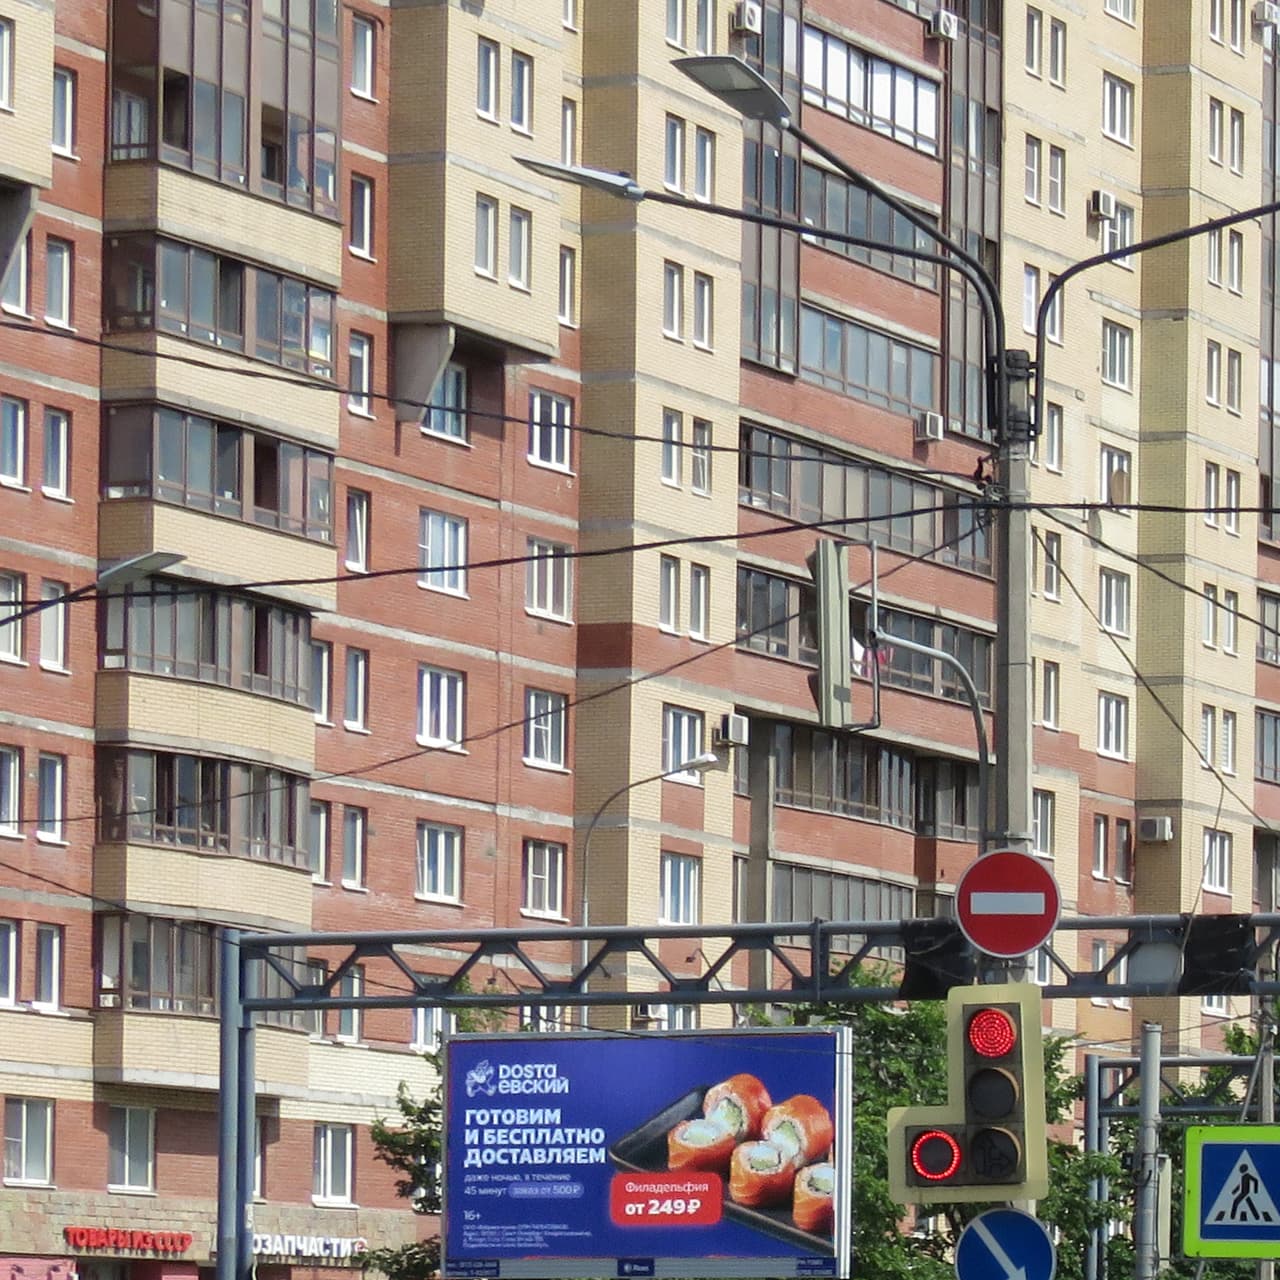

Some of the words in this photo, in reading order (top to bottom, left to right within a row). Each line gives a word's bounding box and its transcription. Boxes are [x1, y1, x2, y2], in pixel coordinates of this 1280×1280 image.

[464, 1108, 562, 1126] ГОТОВИМ
[464, 1128, 480, 1146] И
[483, 1127, 606, 1146] БЕСПЛАТНО
[463, 1147, 607, 1169] ДОСТАВЛЯЕМ
[463, 1185, 478, 1196] 45
[624, 1181, 709, 1195] Филадельфия
[463, 1209, 481, 1221] 16+
[624, 1202, 646, 1216] от
[64, 1226, 130, 1249] ТОВАРЫ
[252, 1232, 352, 1258] ОЗАПЧАСТИ
